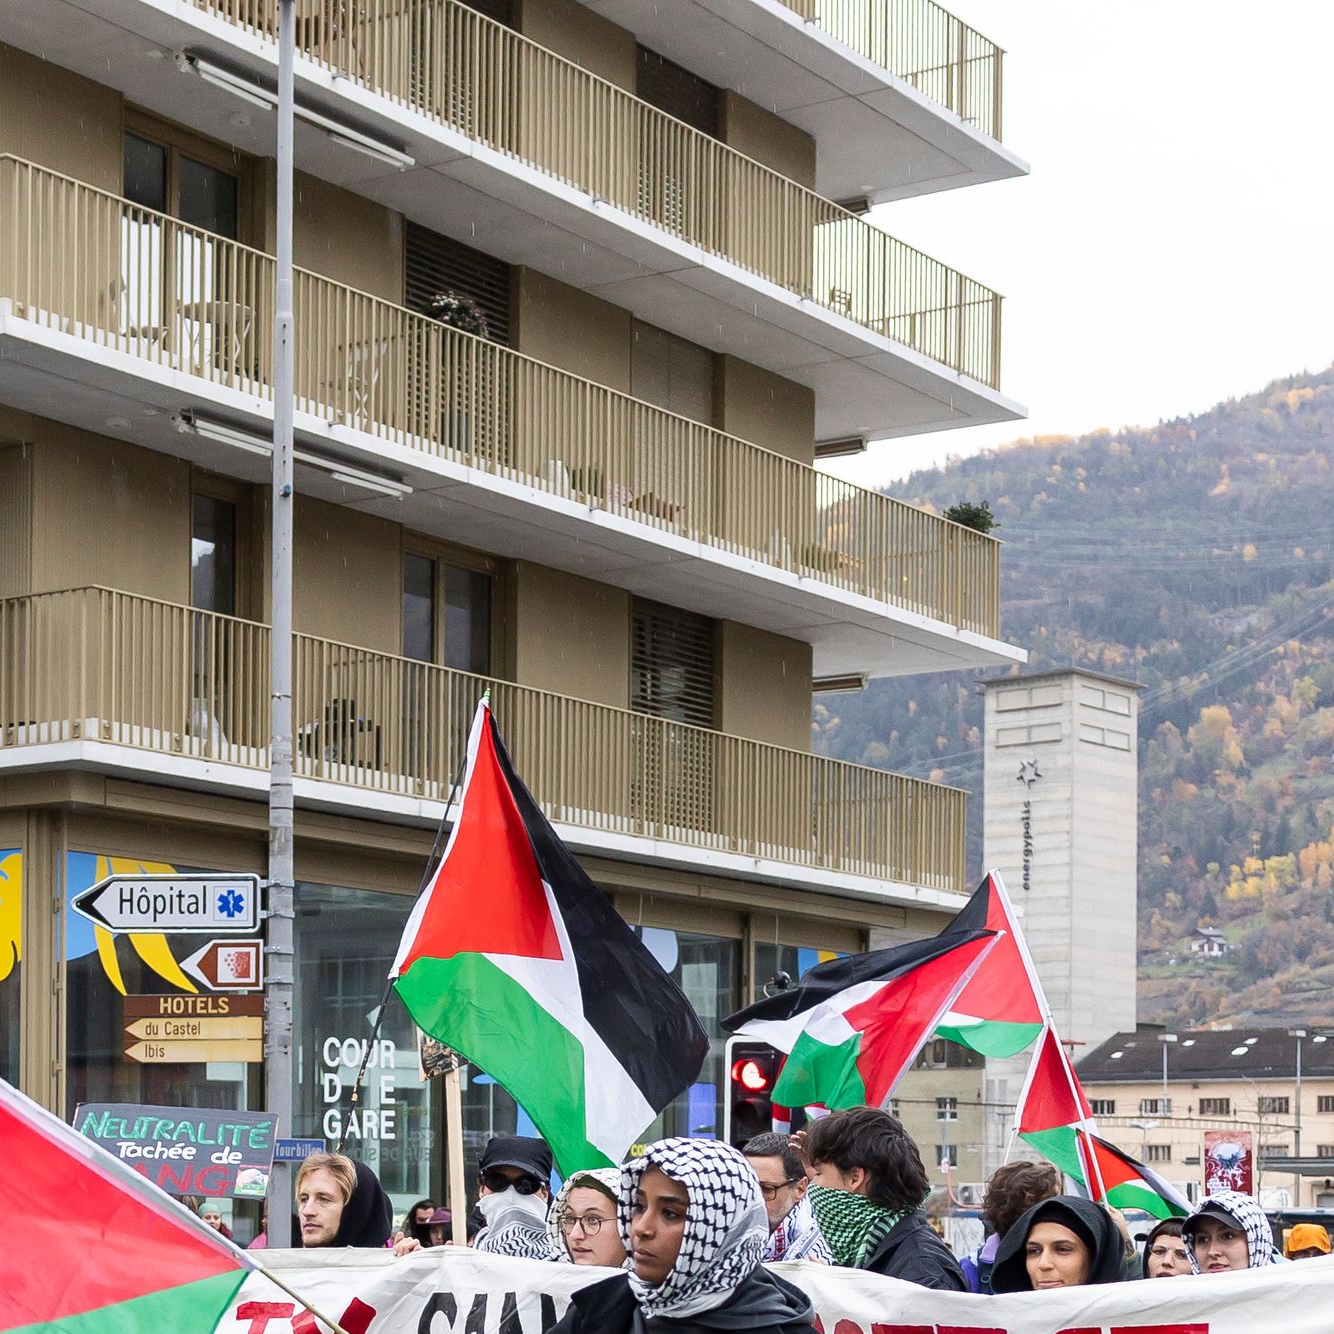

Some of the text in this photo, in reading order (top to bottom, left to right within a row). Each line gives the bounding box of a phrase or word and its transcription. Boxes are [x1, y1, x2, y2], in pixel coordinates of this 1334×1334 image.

[1021, 800, 1034, 891] energypolis
[119, 885, 207, 922] Hôpital
[159, 997, 229, 1014] HOTELS
[145, 1022, 201, 1036] du Castel
[144, 1044, 165, 1058] Ibis
[323, 1036, 396, 1070] COUR
[79, 1110, 272, 1149] NEUTRALITÉ
[323, 1108, 396, 1140] GARE
[116, 1141, 243, 1165] Tachée de
